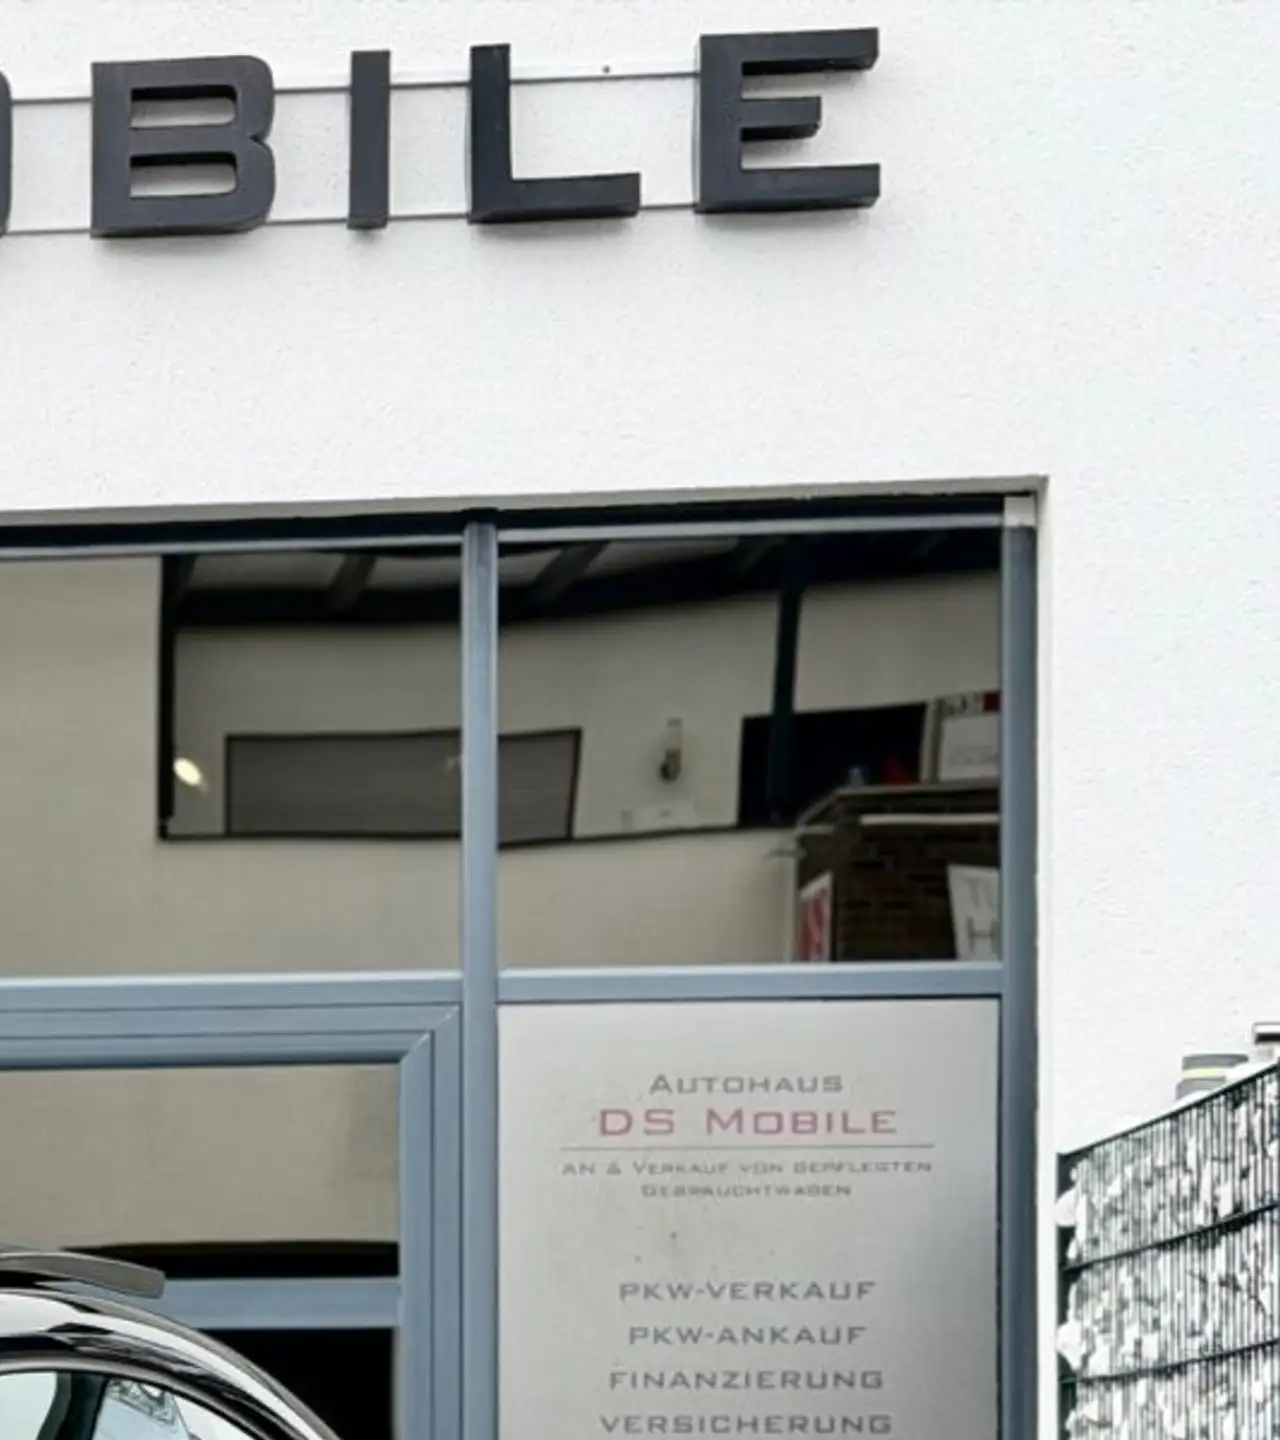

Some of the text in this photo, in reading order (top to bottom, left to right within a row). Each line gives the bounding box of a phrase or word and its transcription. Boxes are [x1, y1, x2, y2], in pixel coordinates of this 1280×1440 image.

[649, 1074, 844, 1094] AUTOHAUS
[599, 1107, 898, 1136] DS MOBILE
[619, 1280, 877, 1301] PKW-VERKAUF
[629, 1326, 867, 1346] PKW-ANKAUF
[608, 1370, 884, 1390] FINANZIERUNG
[600, 1414, 893, 1434] VERSICHERUNG
